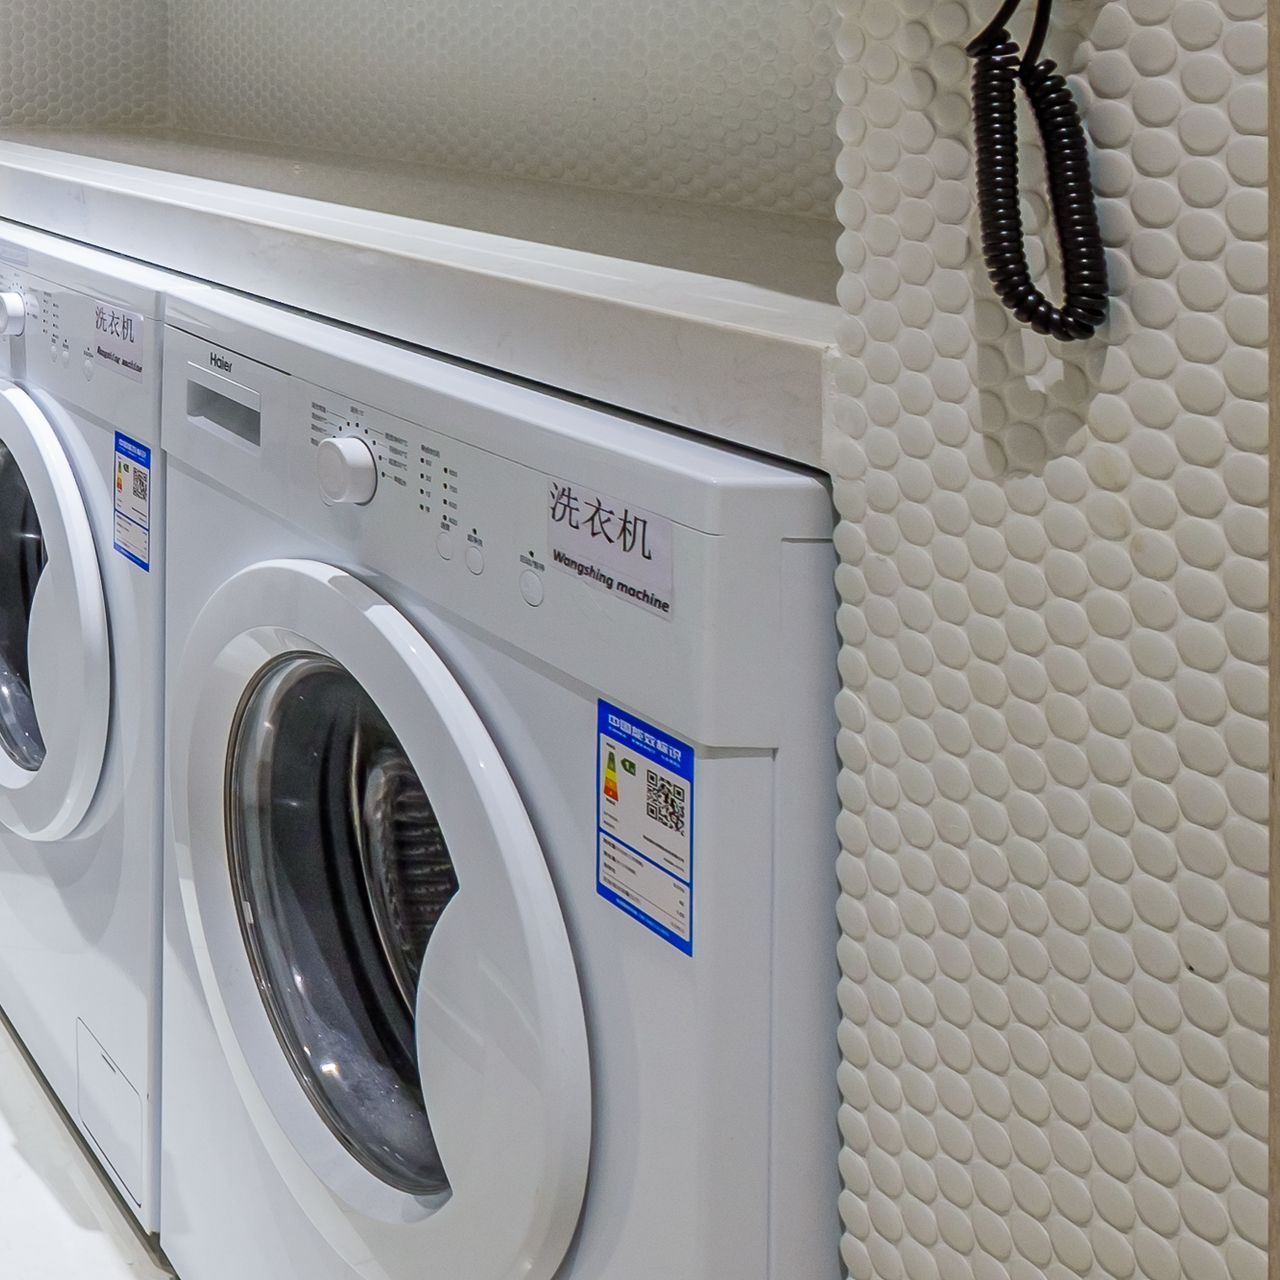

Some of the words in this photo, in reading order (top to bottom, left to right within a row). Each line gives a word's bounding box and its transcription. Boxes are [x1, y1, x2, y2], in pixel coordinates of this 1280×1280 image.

[95, 306, 134, 343] 洗衣机
[210, 352, 233, 373] Haier
[549, 481, 652, 561] 洗衣机
[553, 548, 614, 590] Wangshing
[616, 581, 670, 613] machine
